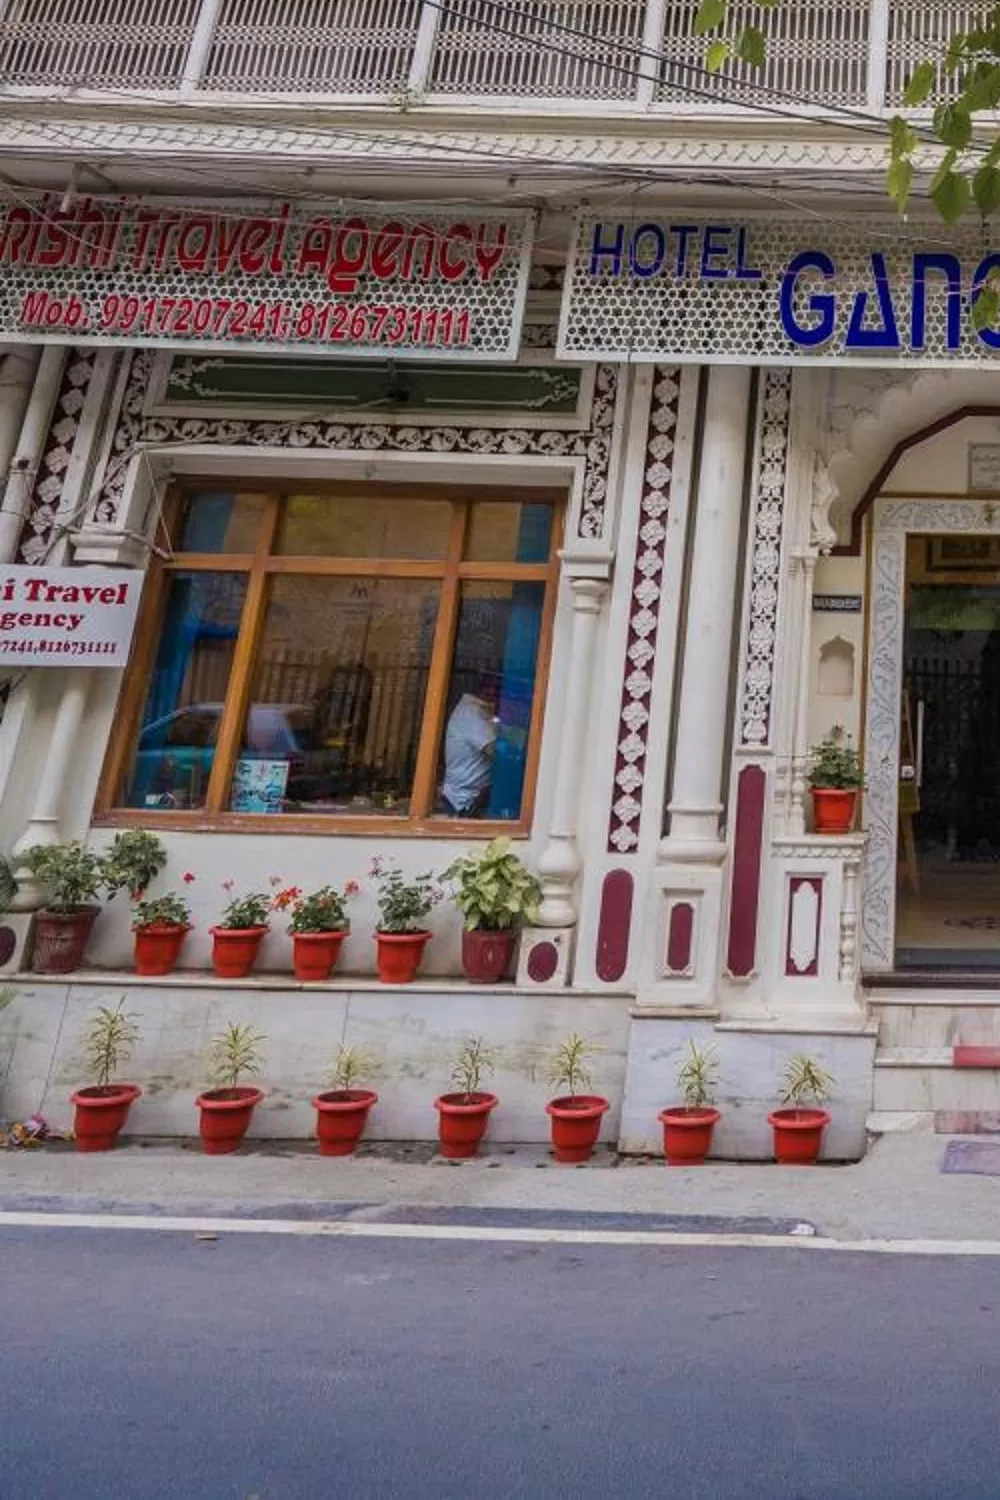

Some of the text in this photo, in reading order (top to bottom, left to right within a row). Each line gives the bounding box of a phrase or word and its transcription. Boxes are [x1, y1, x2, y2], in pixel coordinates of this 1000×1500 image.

[132, 203, 290, 275] Travel
[298, 215, 508, 294] Agency
[589, 223, 763, 278] HOTEL
[22, 292, 89, 326] Mob.
[297, 303, 470, 343] 8126731111
[24, 579, 128, 605] Travel
[0, 612, 85, 631] gency
[0, 640, 118, 654] 7241,8126731111
